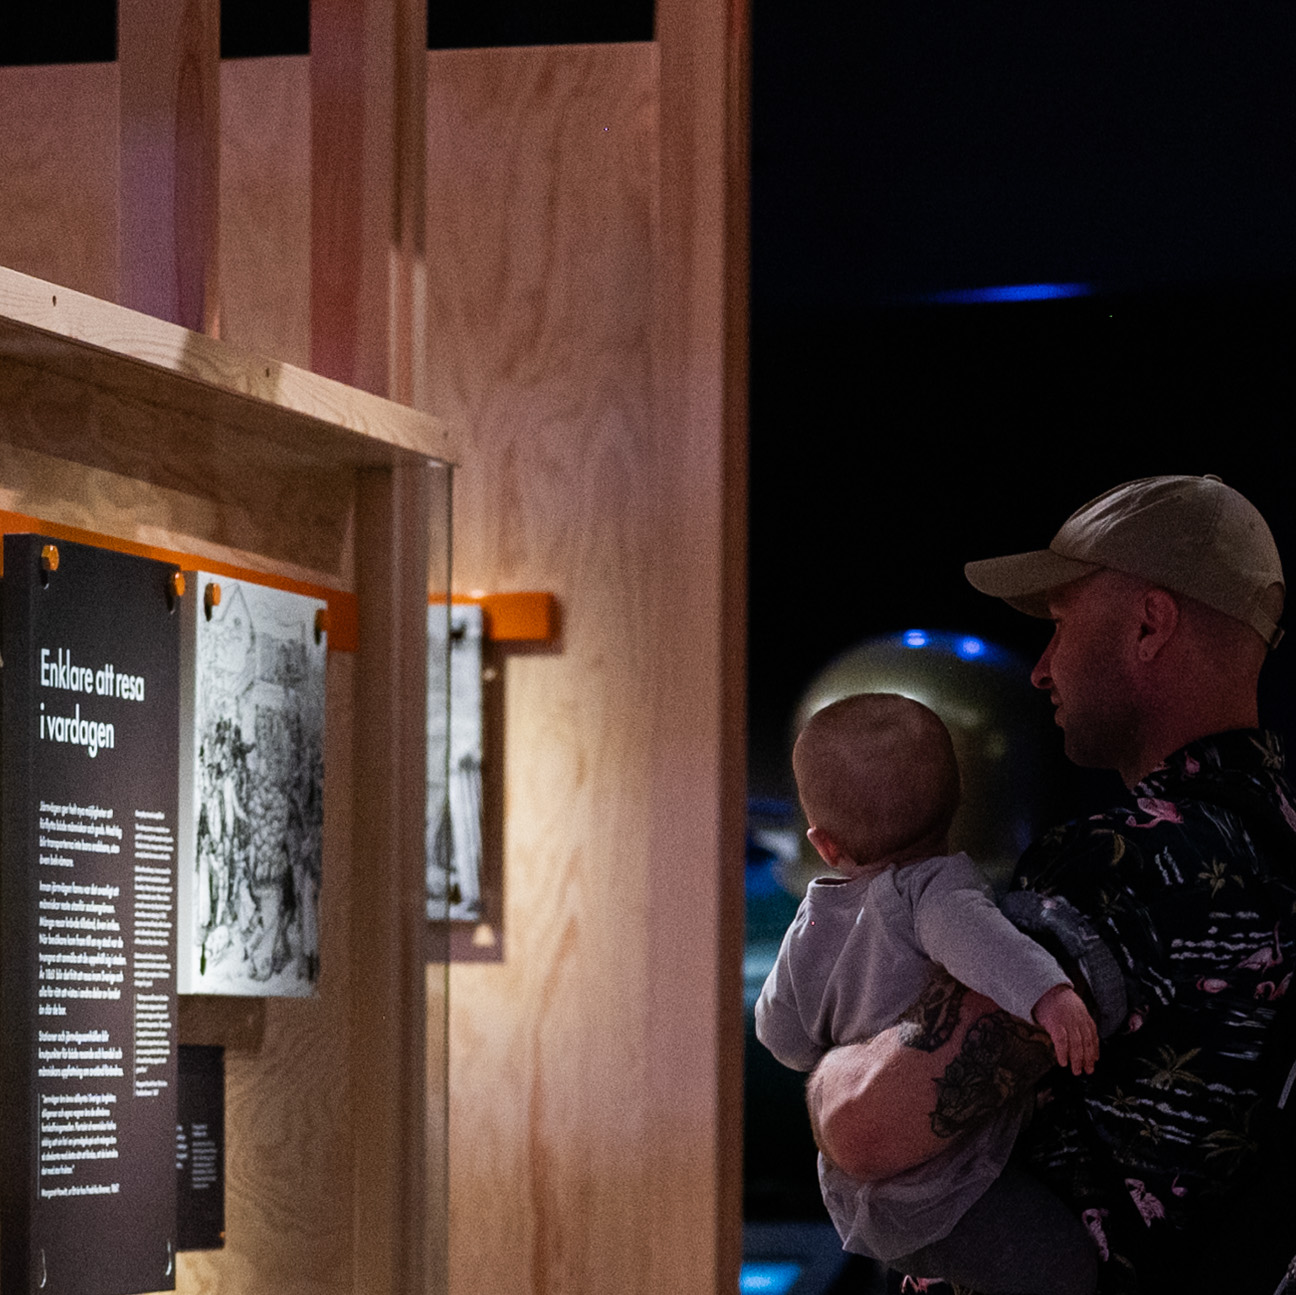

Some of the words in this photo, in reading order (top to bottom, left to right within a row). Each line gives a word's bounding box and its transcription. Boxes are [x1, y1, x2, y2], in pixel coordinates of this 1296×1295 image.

[40, 648, 93, 694] Enklare
[95, 664, 115, 696] att
[116, 673, 145, 702] resa
[40, 702, 45, 739] i
[47, 703, 115, 758] vardagen
